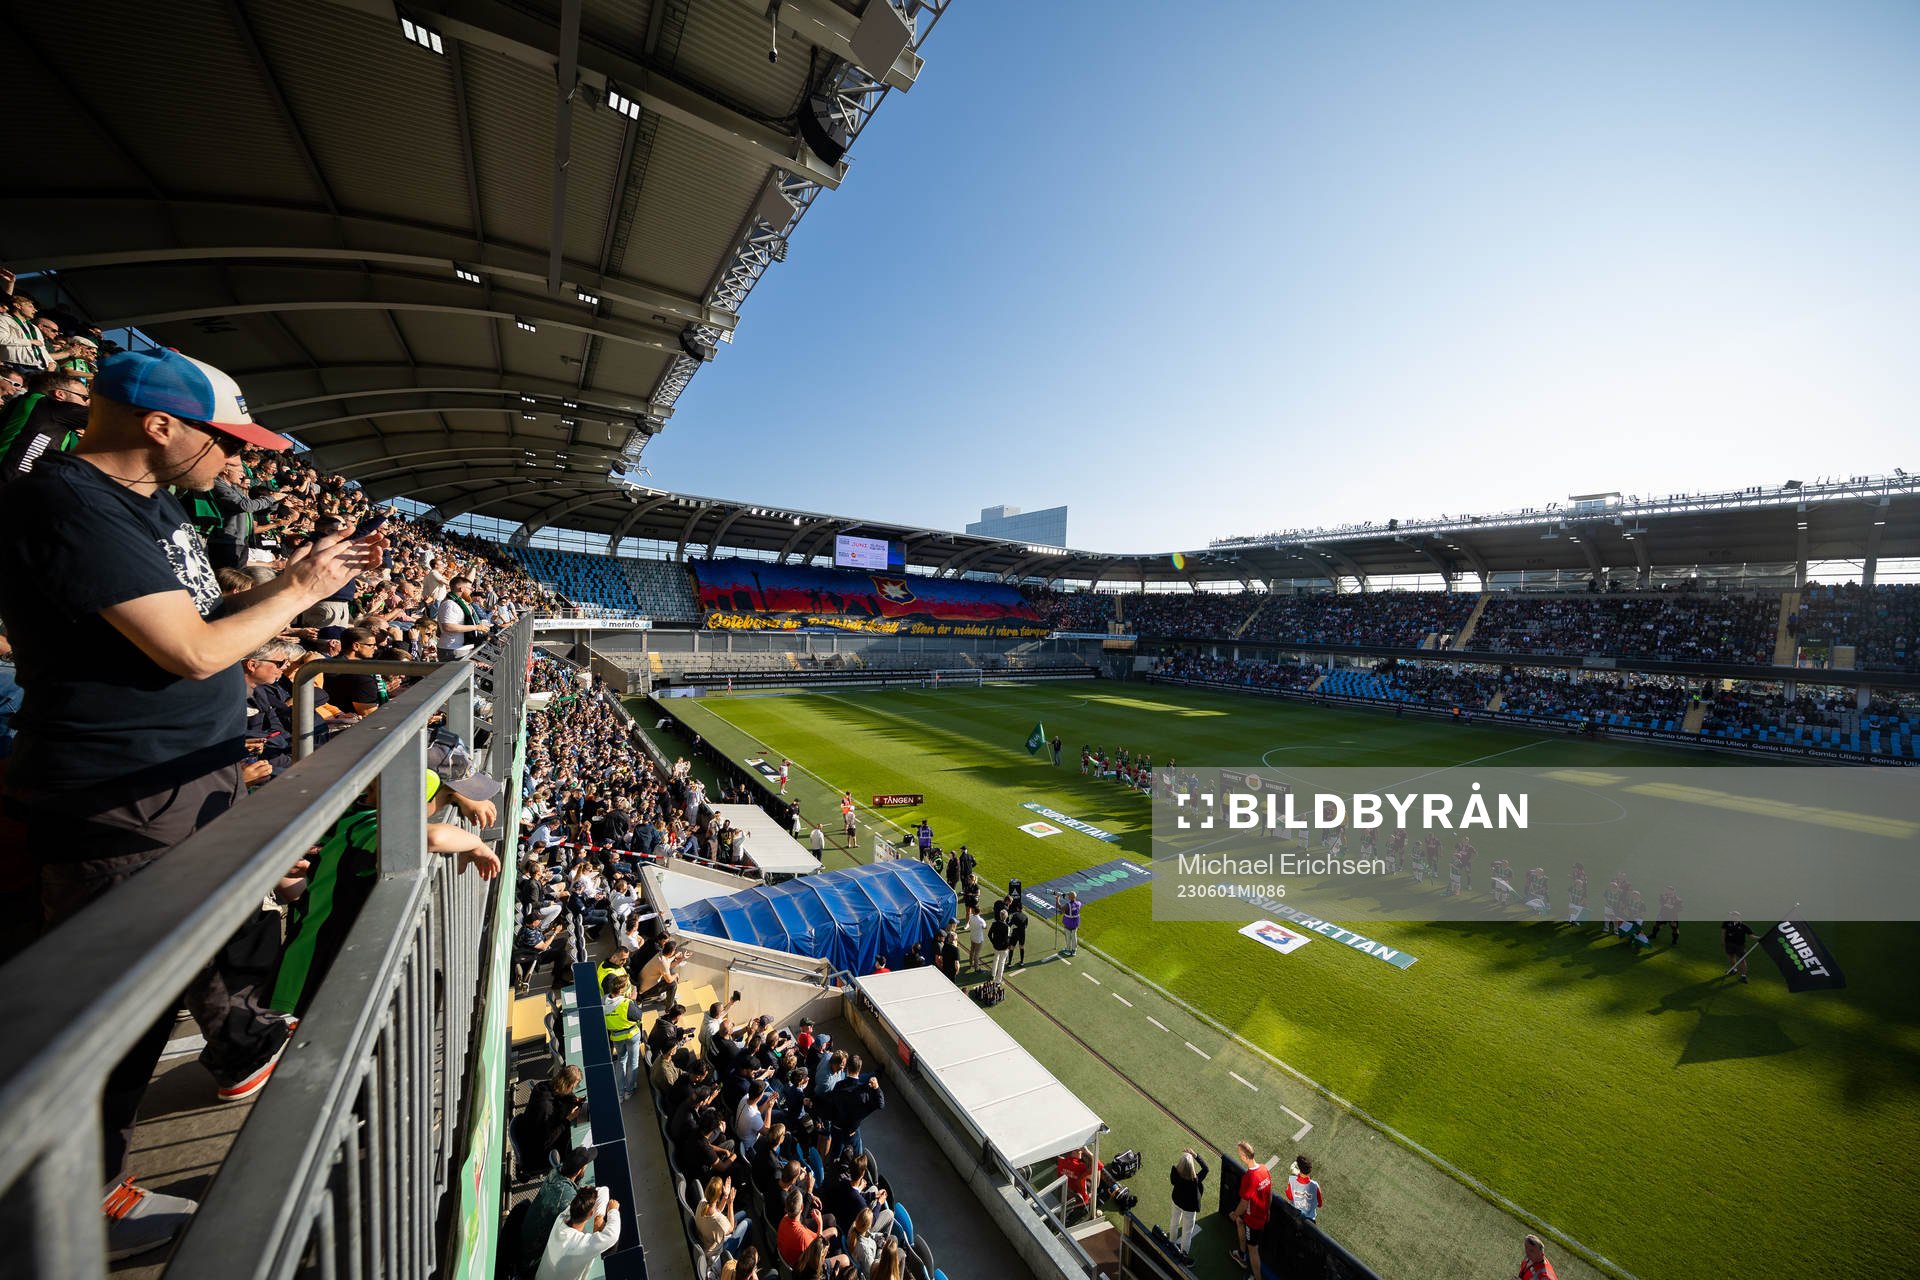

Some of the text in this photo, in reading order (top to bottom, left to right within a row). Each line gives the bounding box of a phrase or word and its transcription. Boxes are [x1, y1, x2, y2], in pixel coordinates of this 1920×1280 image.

[708, 613, 782, 630] Göteb
[910, 622, 935, 635] stan
[953, 623, 988, 636] målad
[883, 794, 914, 805] TÅNGEN
[1025, 892, 1057, 910] UNIBET
[1248, 895, 1399, 961] SUPERETTAN
[1777, 920, 1831, 977] UNIBET
